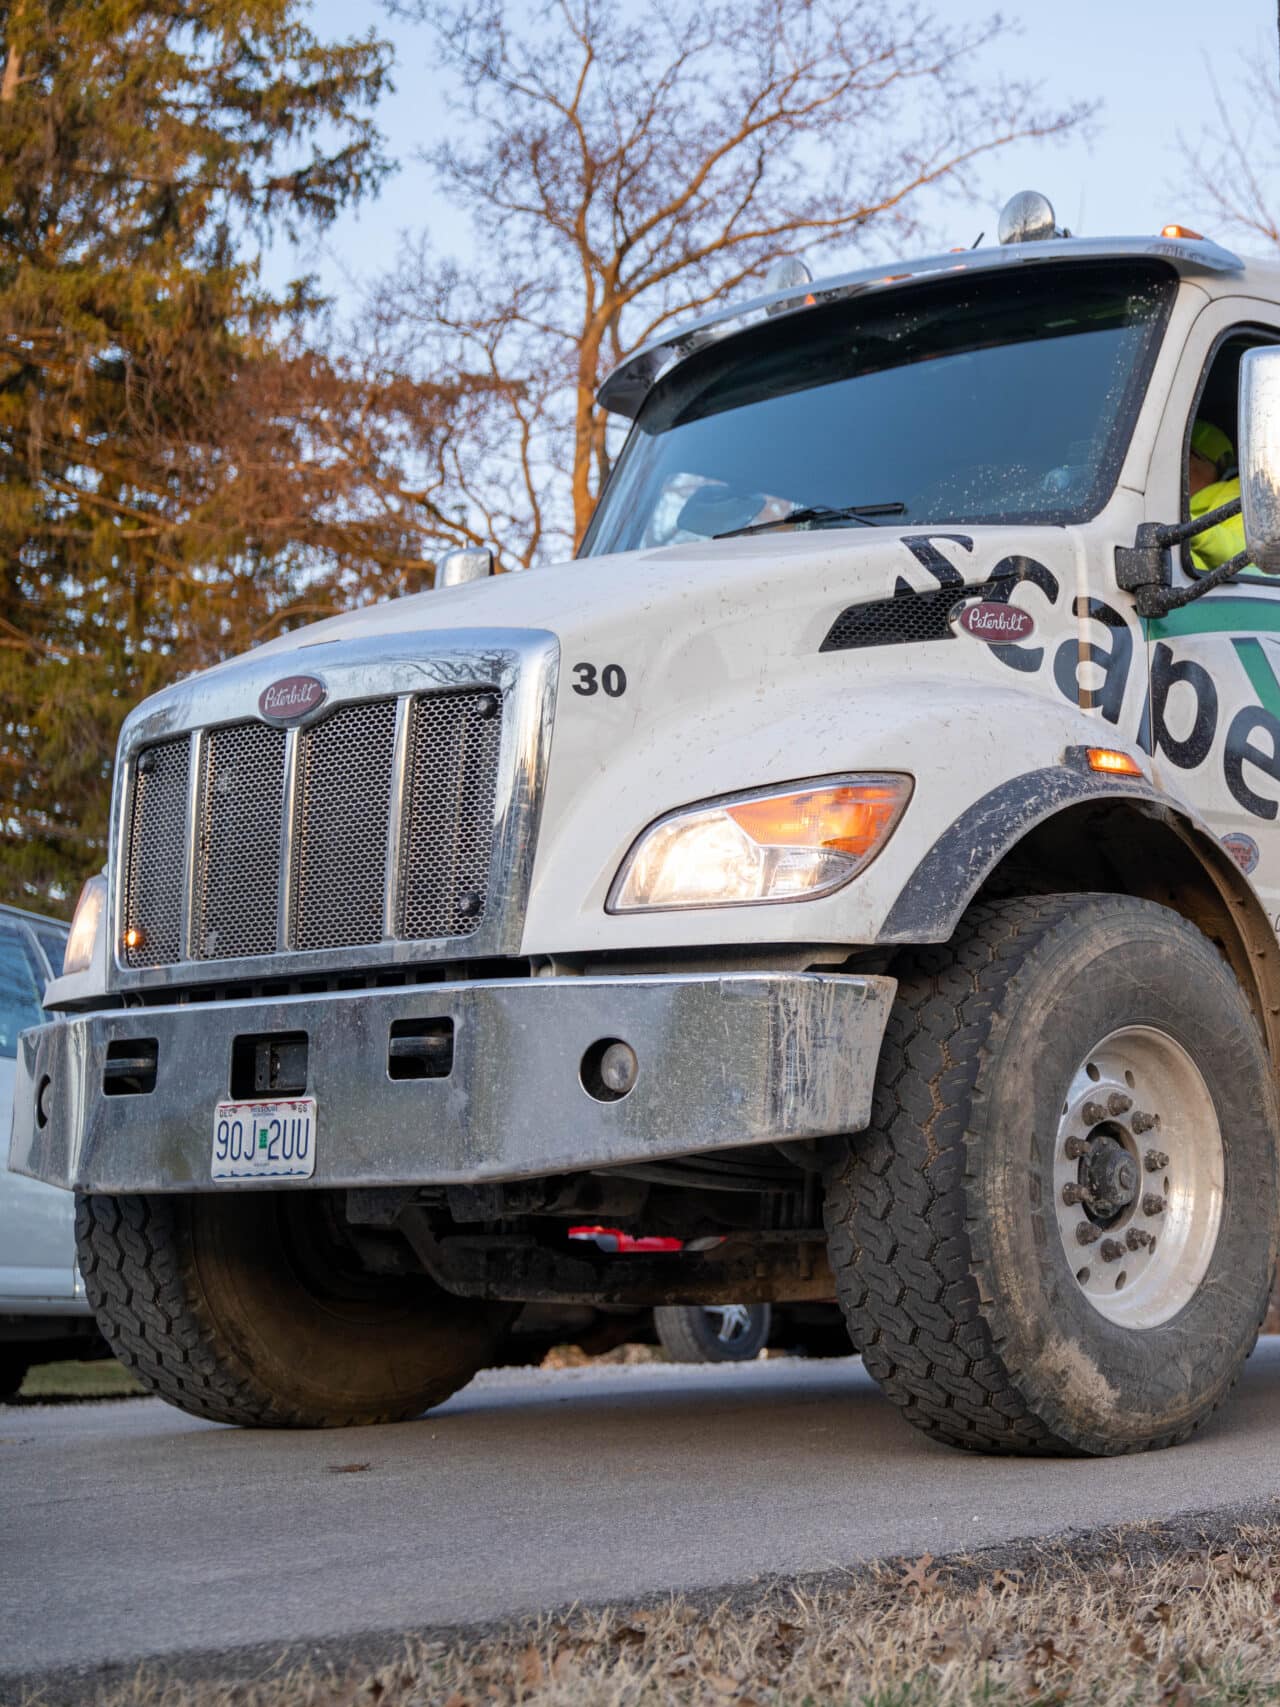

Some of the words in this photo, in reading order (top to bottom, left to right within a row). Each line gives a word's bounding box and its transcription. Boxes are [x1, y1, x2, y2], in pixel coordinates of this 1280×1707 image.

[968, 608, 1028, 631] Peterbilt
[572, 662, 627, 697] 30
[264, 683, 318, 710] Peterbilt
[216, 1119, 257, 1161] 90J
[267, 1118, 310, 1161] 2UU
